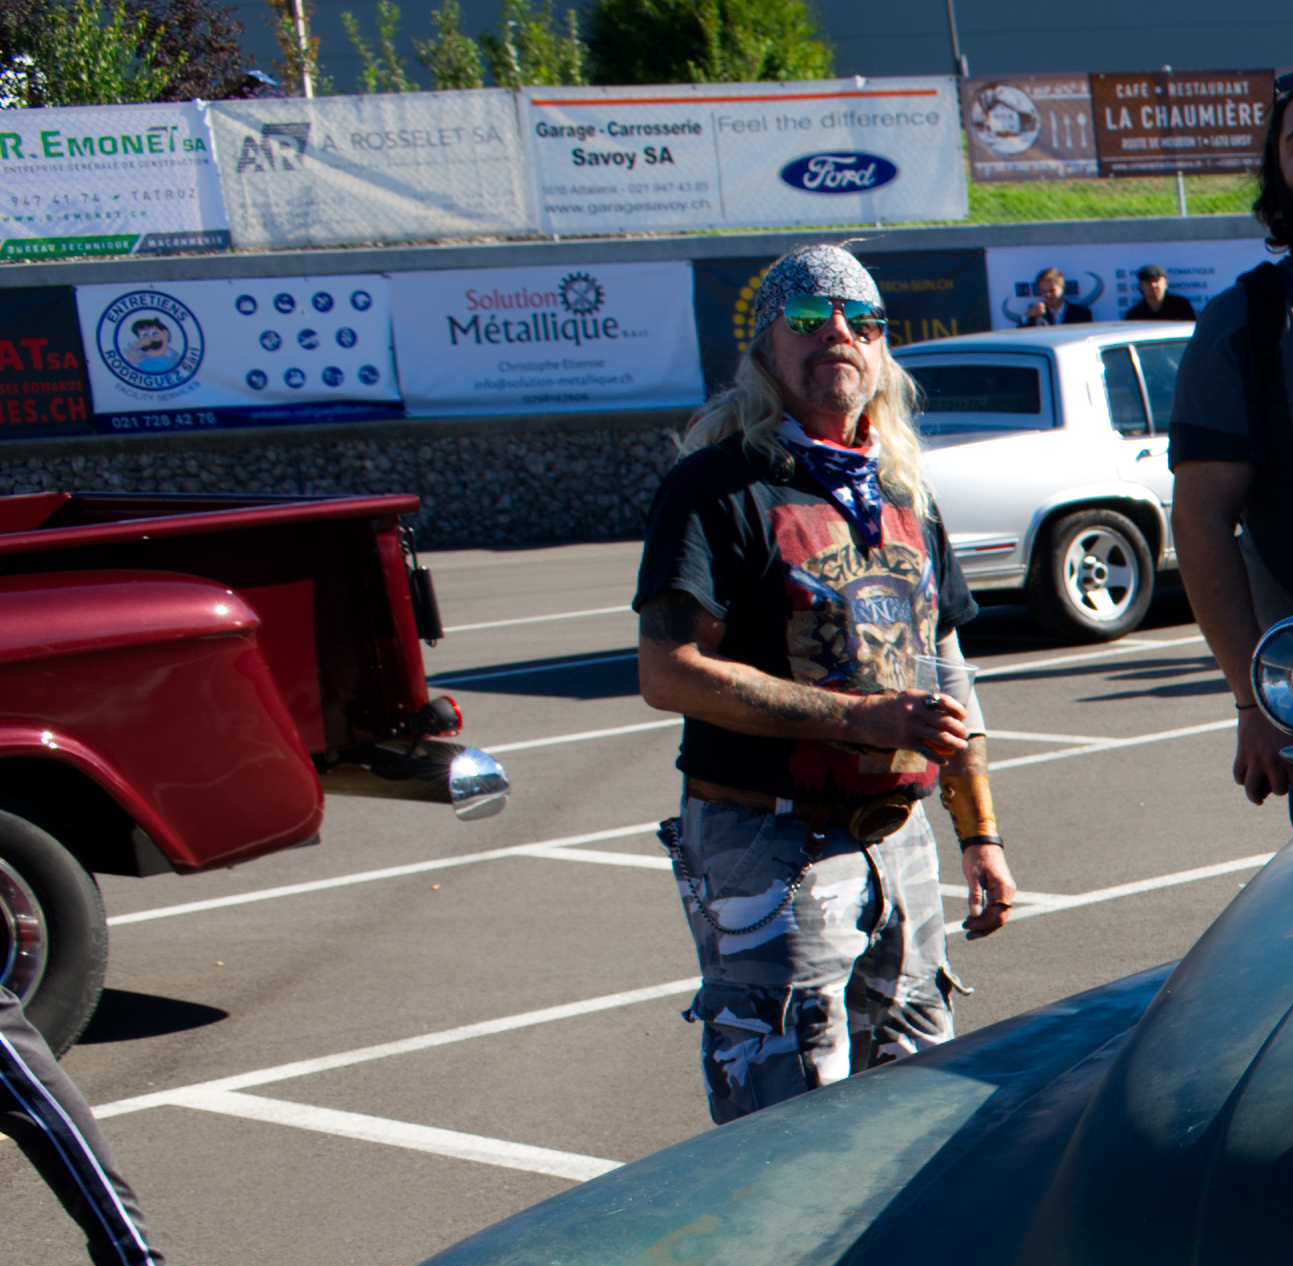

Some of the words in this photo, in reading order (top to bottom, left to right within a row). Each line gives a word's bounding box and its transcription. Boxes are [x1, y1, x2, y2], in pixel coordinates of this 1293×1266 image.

[1115, 82, 1149, 99] CAFÉ
[1167, 80, 1250, 97] RESTAURANT
[717, 114, 768, 133] Feel
[776, 114, 812, 131] the
[820, 109, 941, 129] difference
[1105, 107, 1133, 131] LA
[1141, 99, 1265, 129] CHAUMIÈRE
[351, 128, 466, 151] ROSSELET
[473, 125, 503, 145] SA
[536, 121, 596, 140] Garage
[607, 118, 702, 136] Carrosserie
[182, 137, 207, 152] SA
[571, 147, 637, 170] Savoy
[643, 146, 675, 165] SA
[803, 155, 877, 189] Ford
[106, 294, 189, 324] ENTRETIENS
[464, 287, 559, 312] Solution
[446, 311, 619, 347] Métallique
[104, 348, 185, 388] RODRIGUEZ
[112, 416, 139, 430] 021
[174, 412, 194, 427] 42
